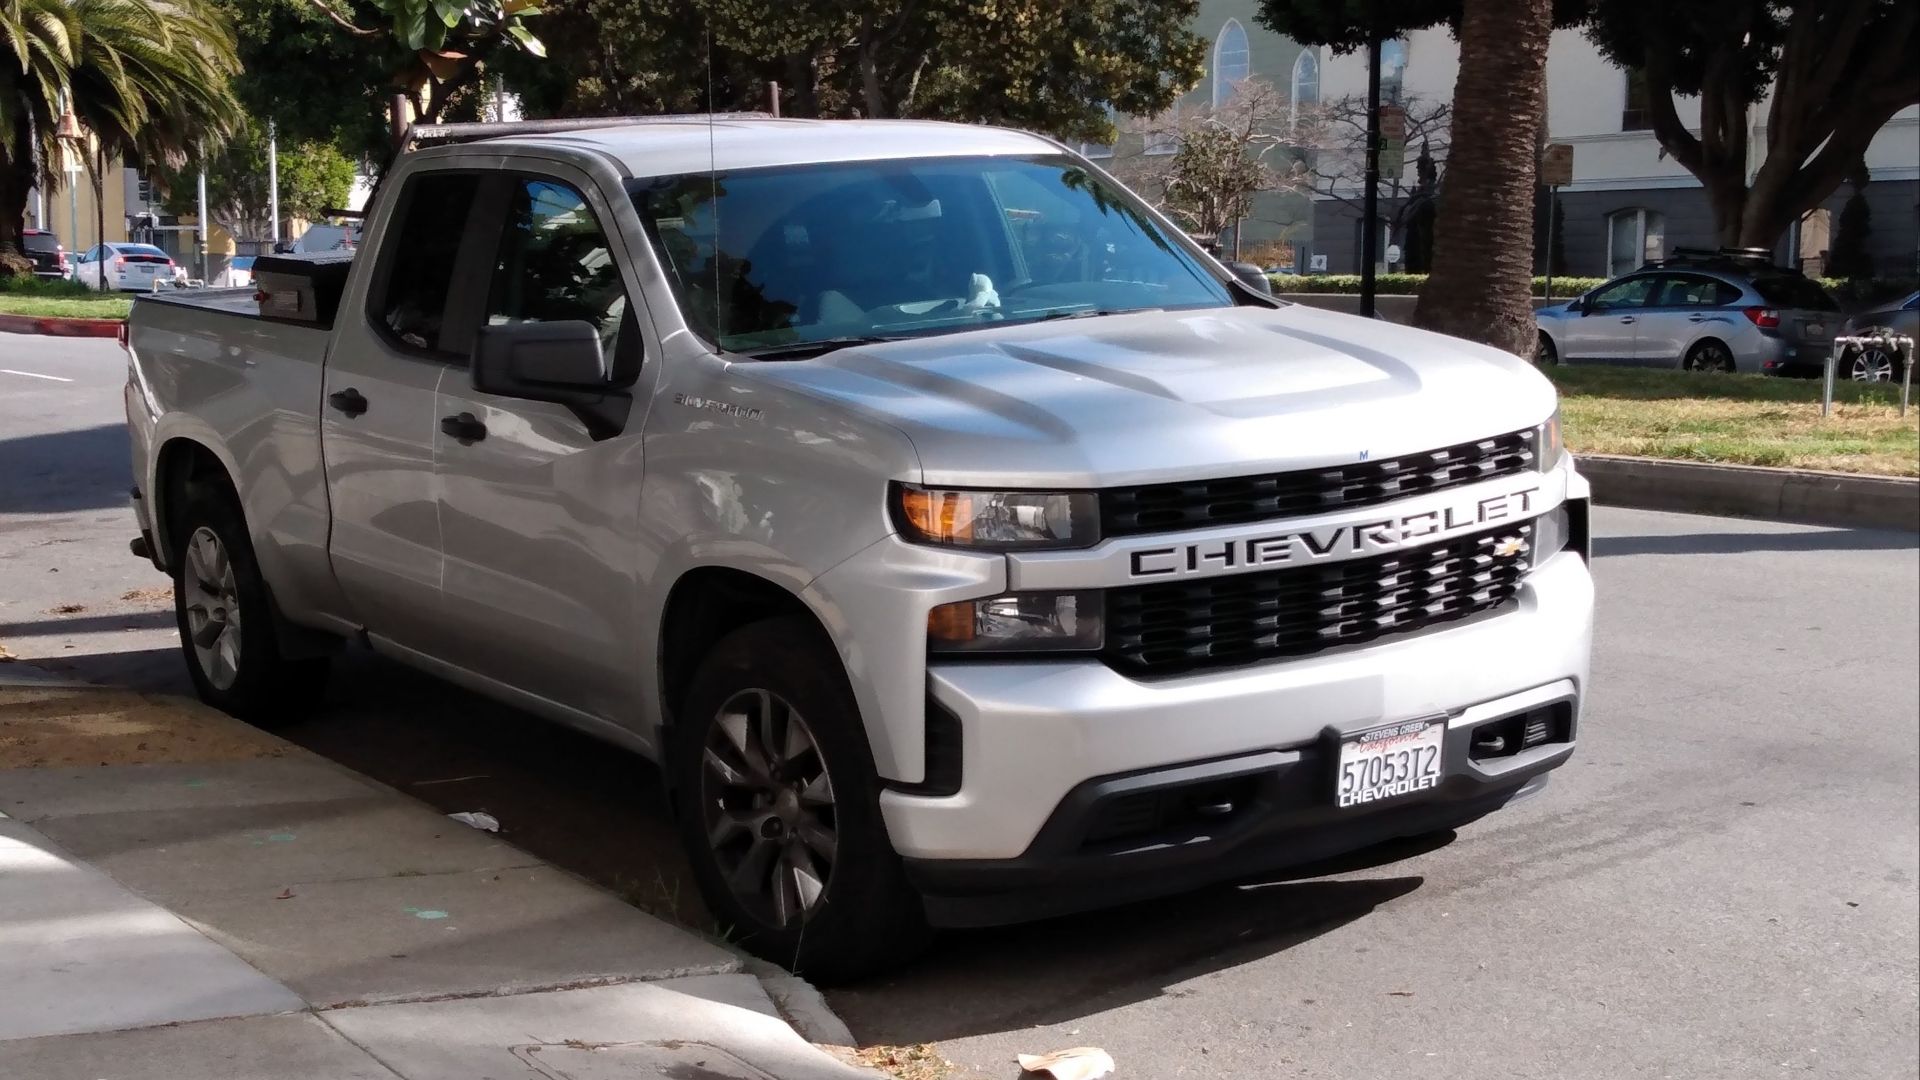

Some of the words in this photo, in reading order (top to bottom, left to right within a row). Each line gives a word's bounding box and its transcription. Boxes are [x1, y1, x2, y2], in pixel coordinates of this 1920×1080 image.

[1359, 450, 1369, 461] M
[1130, 486, 1540, 578] CHEVROLET
[1364, 727, 1398, 741] STEVENS
[1400, 721, 1424, 734] CREEK
[1343, 744, 1438, 793] 57053T2
[1339, 771, 1441, 807] CHEVROLET
